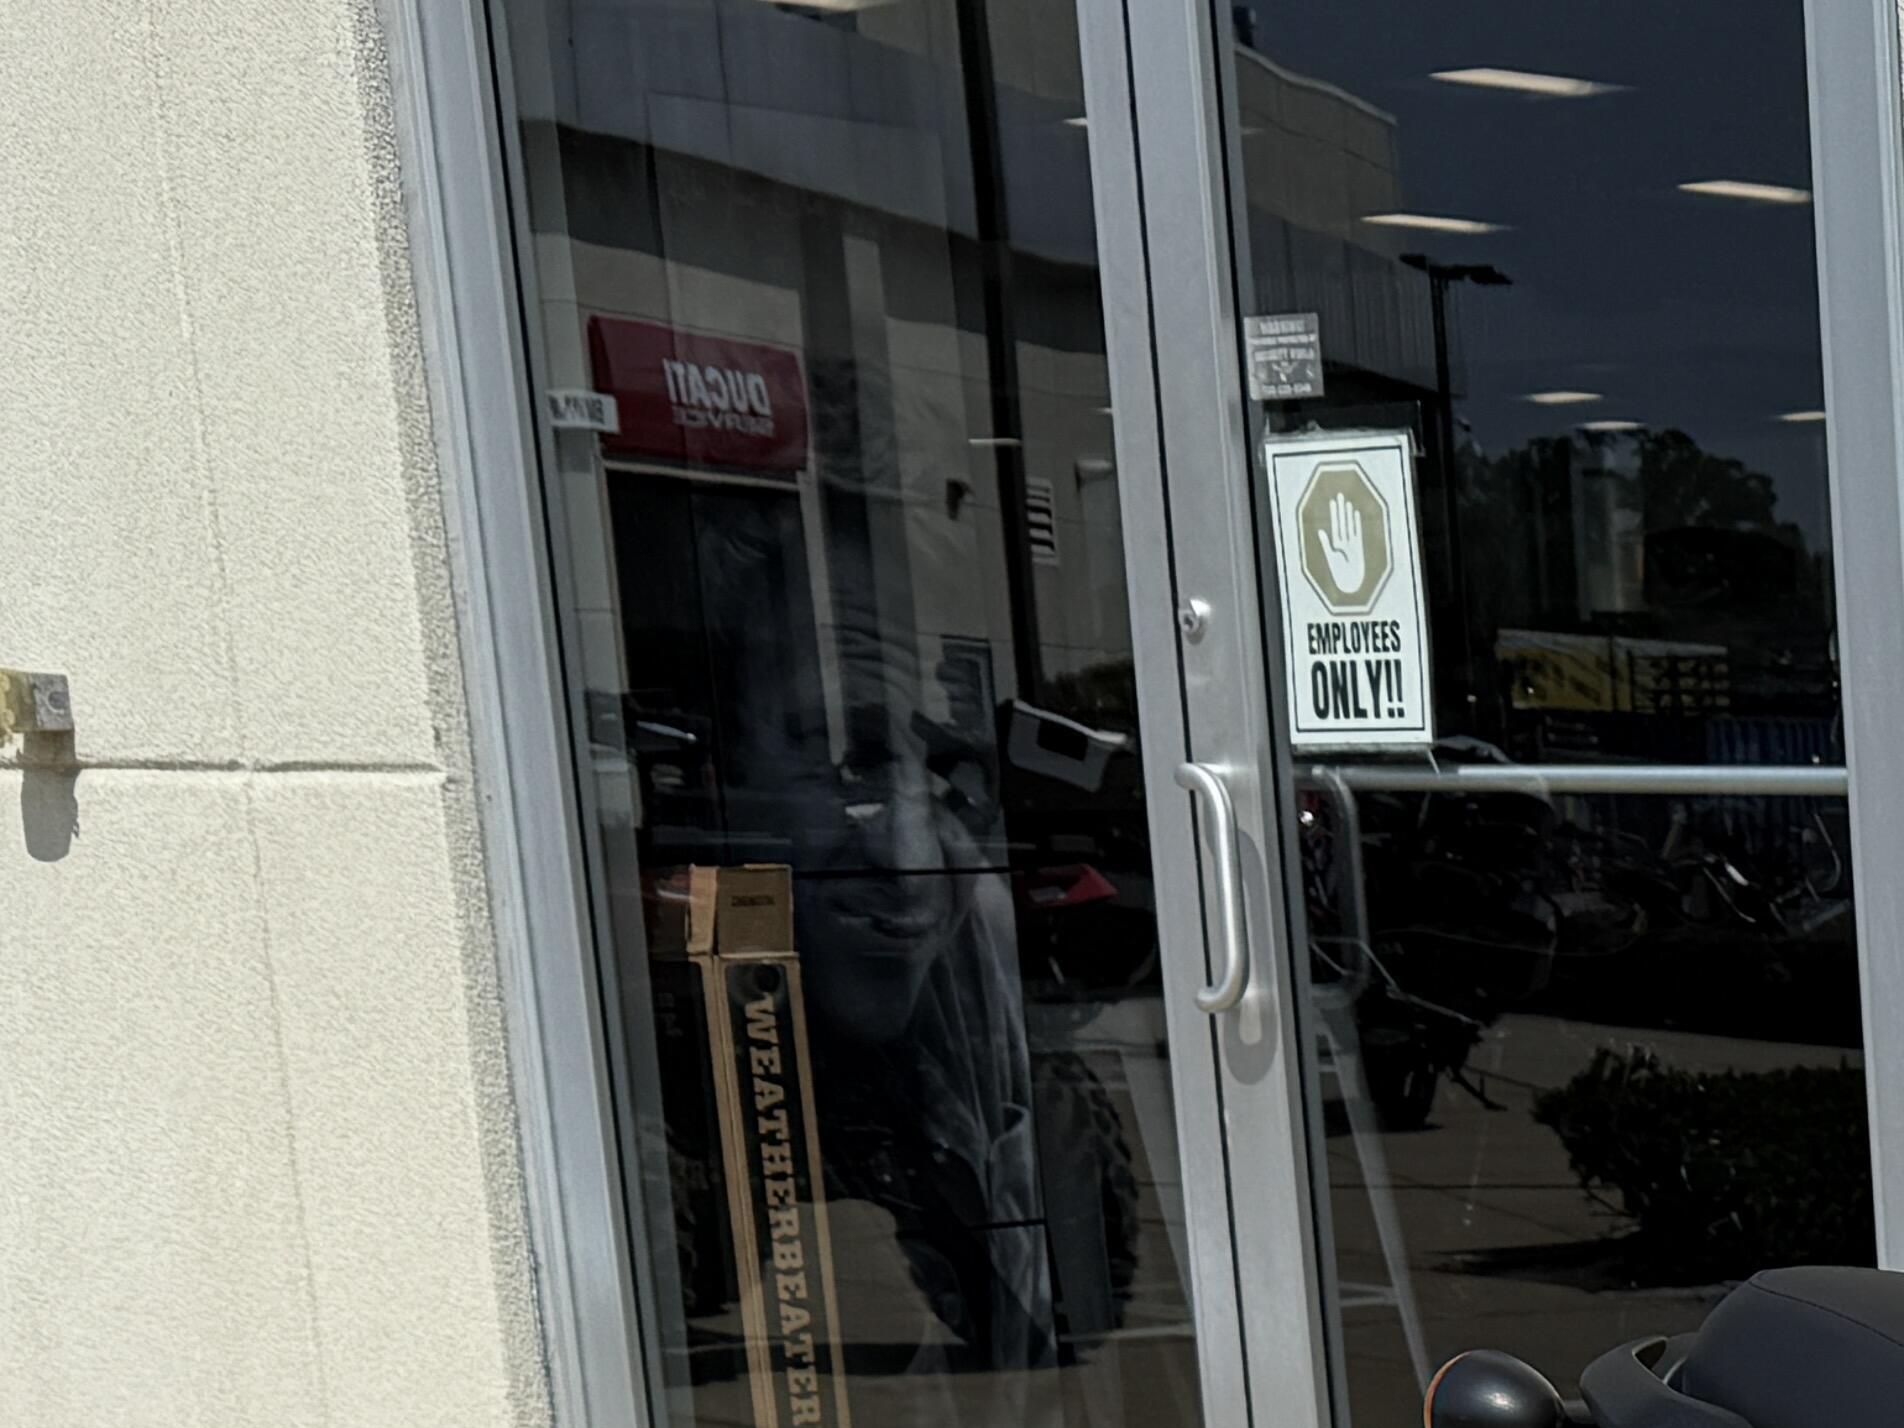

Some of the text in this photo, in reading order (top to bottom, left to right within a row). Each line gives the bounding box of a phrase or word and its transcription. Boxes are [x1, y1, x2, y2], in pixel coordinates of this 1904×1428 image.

[1307, 620, 1401, 655] EMPLOYEES
[1311, 659, 1405, 719] ONLY!!
[744, 992, 822, 1427] WEATHERBEATER
